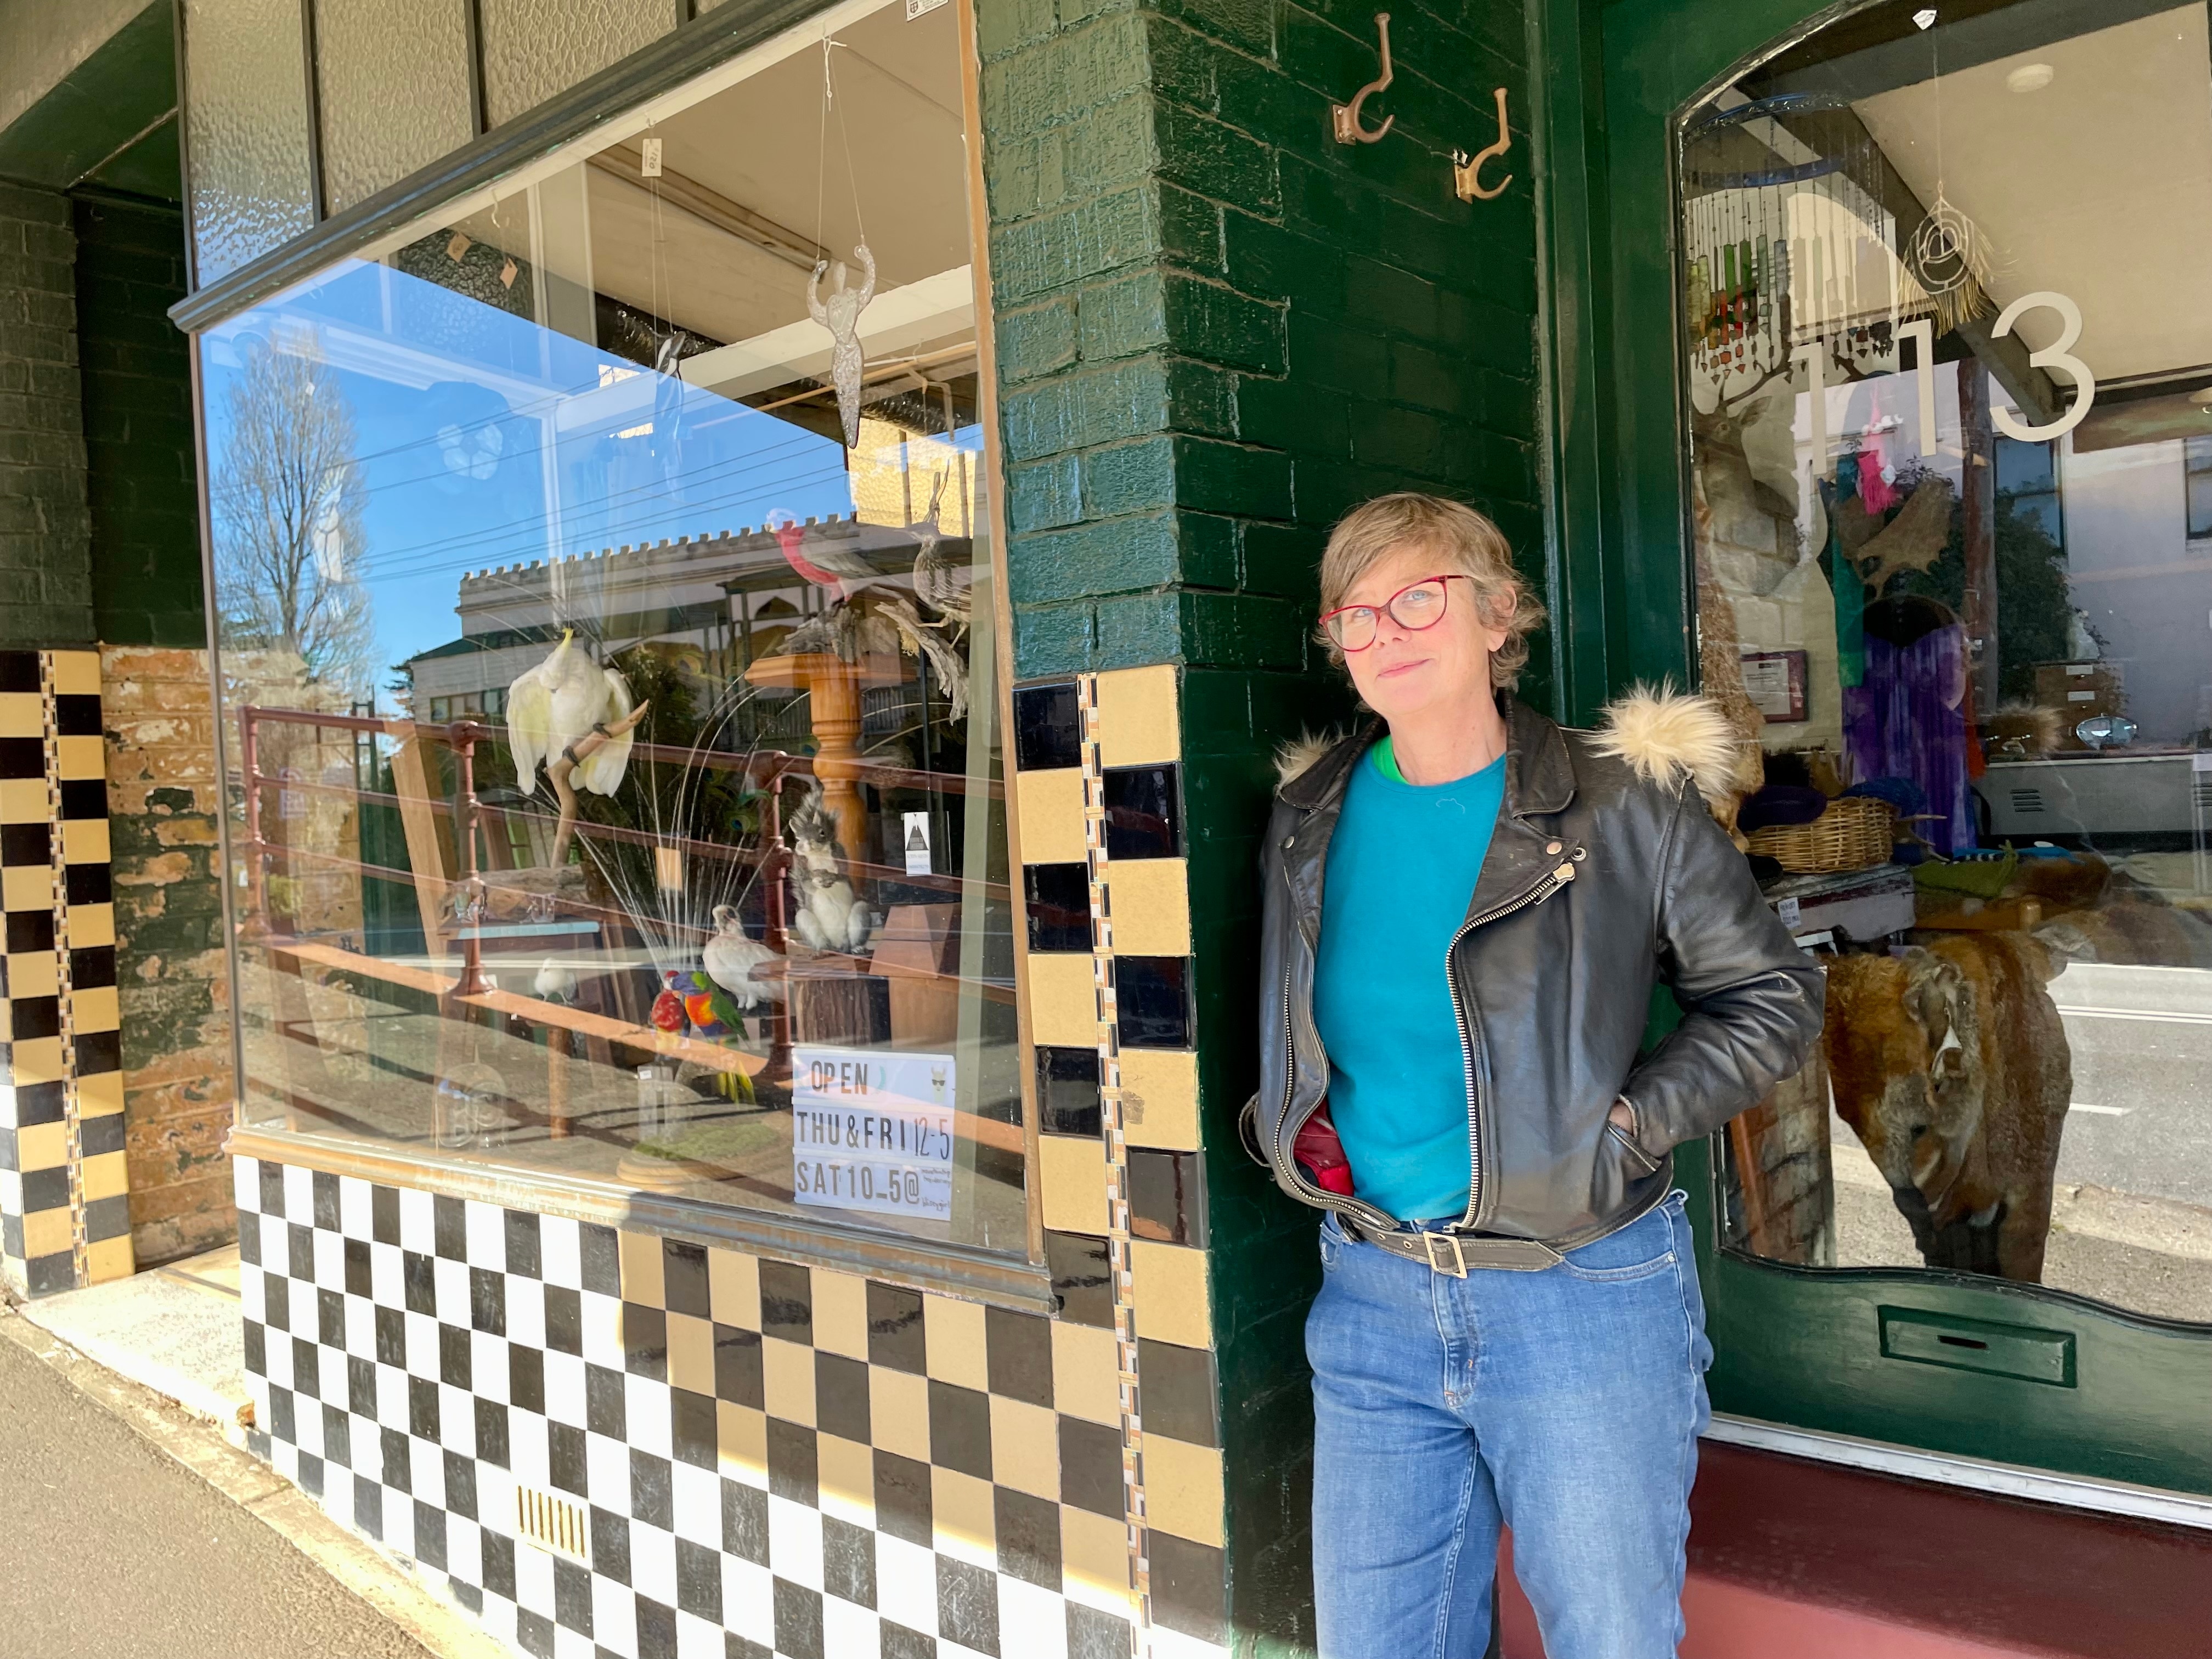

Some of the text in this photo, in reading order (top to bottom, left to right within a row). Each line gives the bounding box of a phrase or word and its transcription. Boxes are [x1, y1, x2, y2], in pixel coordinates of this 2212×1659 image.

[1788, 291, 2095, 475] 113
[811, 1060, 868, 1095] OPEN
[797, 1111, 950, 1160] THU & FRI 12-5
[797, 1161, 840, 1195] SAT
